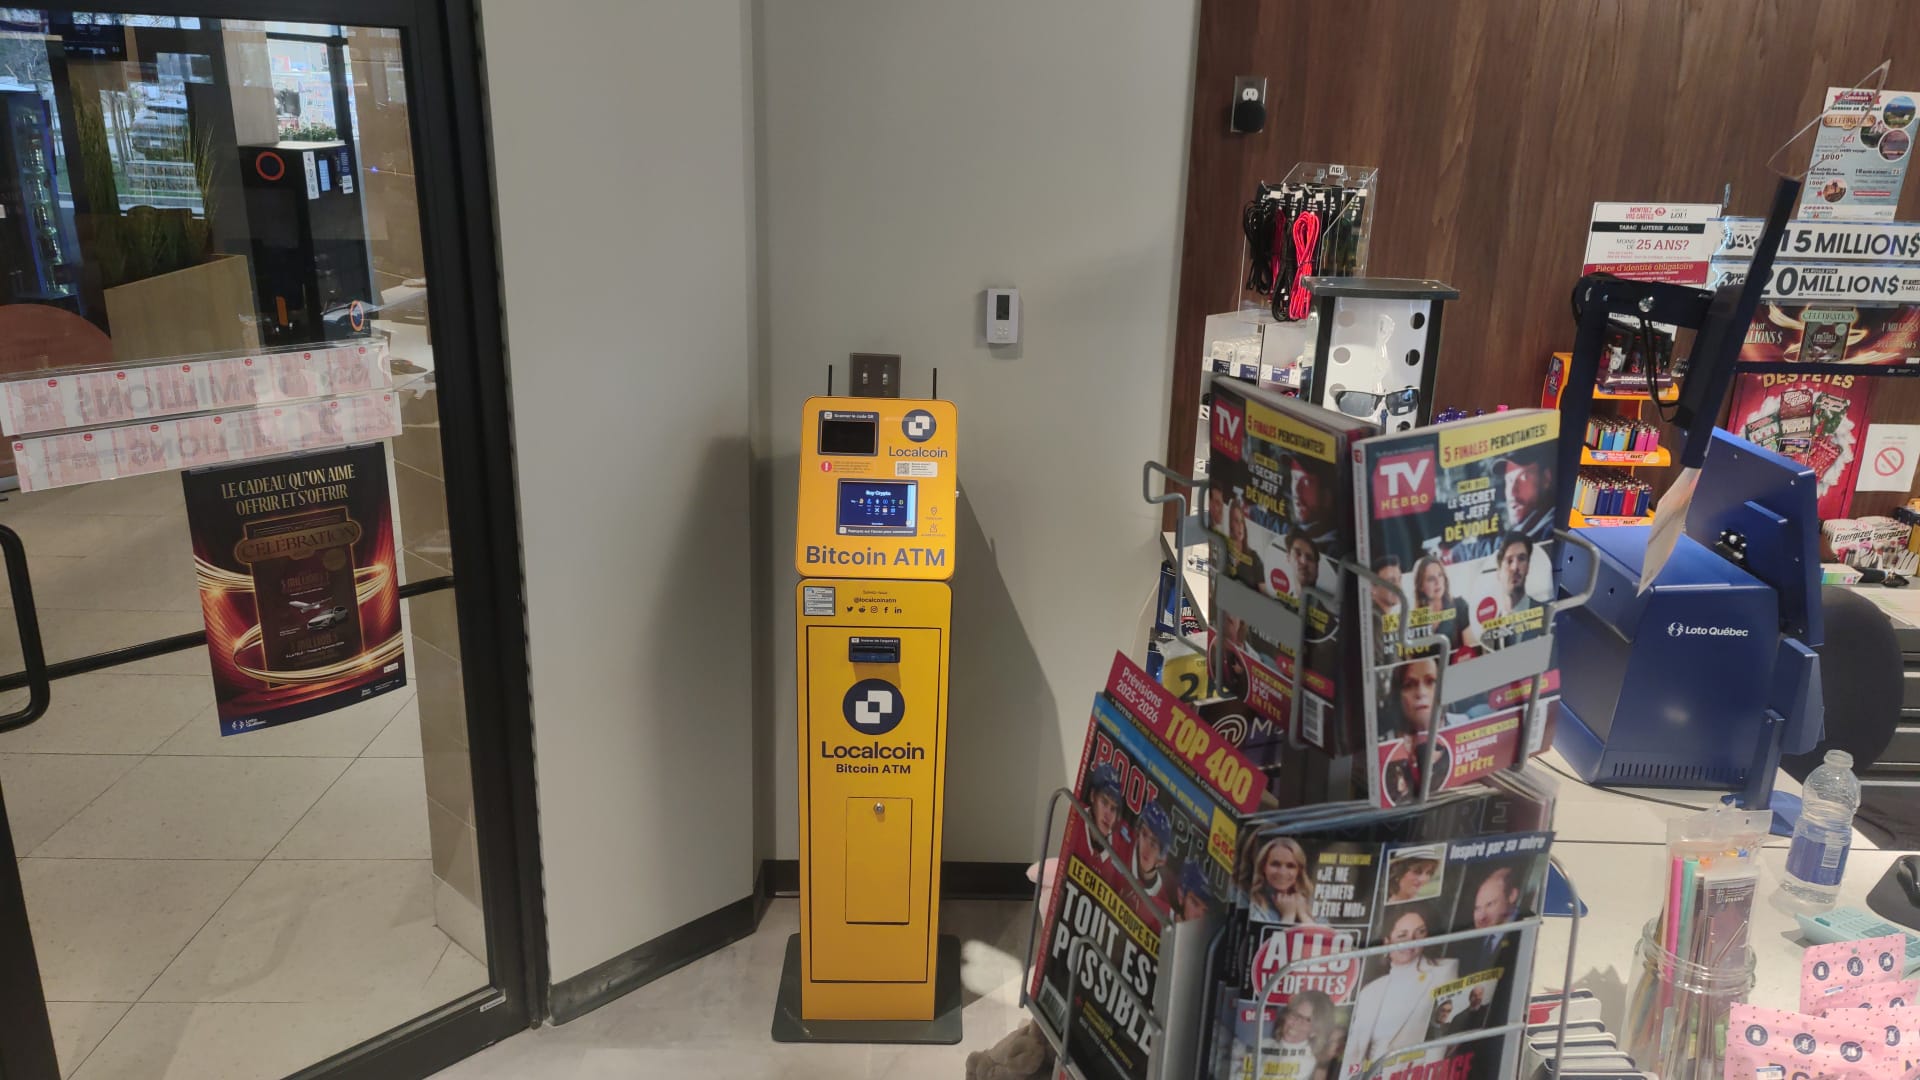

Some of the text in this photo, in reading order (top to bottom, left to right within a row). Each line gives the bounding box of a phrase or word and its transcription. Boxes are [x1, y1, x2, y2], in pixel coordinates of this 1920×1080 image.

[1636, 239, 1690, 251] 25 ANS?
[1780, 229, 1812, 253] 15
[1653, 263, 1694, 273] obligatoire
[1215, 405, 1241, 441] TV
[889, 445, 948, 459] Localcoin
[1443, 446, 1452, 463] 5
[1454, 440, 1489, 460] FINALES
[221, 463, 356, 499] LE CADEAU QU'ON AIME
[1255, 465, 1284, 486] SECRET
[1379, 458, 1430, 497] TV
[236, 483, 349, 516] OFFRIR ET S'OFFRIR
[1381, 493, 1430, 511] HEBDO
[1448, 488, 1497, 509] LE SECRET
[1466, 504, 1491, 520] JEFF
[1445, 513, 1500, 543] DÉVOILÉ
[1834, 529, 1874, 543] Energizer
[806, 545, 946, 567] Bitcoin ATM
[1685, 625, 1749, 637] Loto Québec
[1121, 666, 1163, 708] Prévisions
[1116, 678, 1160, 724] 2025-2026
[821, 740, 925, 760] Localcoin
[1165, 706, 1254, 806] TOP 400
[1456, 745, 1466, 754] LA
[836, 763, 911, 775] Bitcoin ATM
[1091, 731, 1160, 815] POO
[1455, 755, 1496, 778] EN FÊTE
[1071, 860, 1083, 878] LE
[1083, 868, 1097, 893] CH
[1097, 879, 1108, 901] ET
[1108, 889, 1119, 913] LA
[1119, 904, 1144, 938] COUPE
[1314, 884, 1355, 901] PERMETS
[1062, 880, 1120, 960] TOUT
[1262, 930, 1354, 974] ALLO
